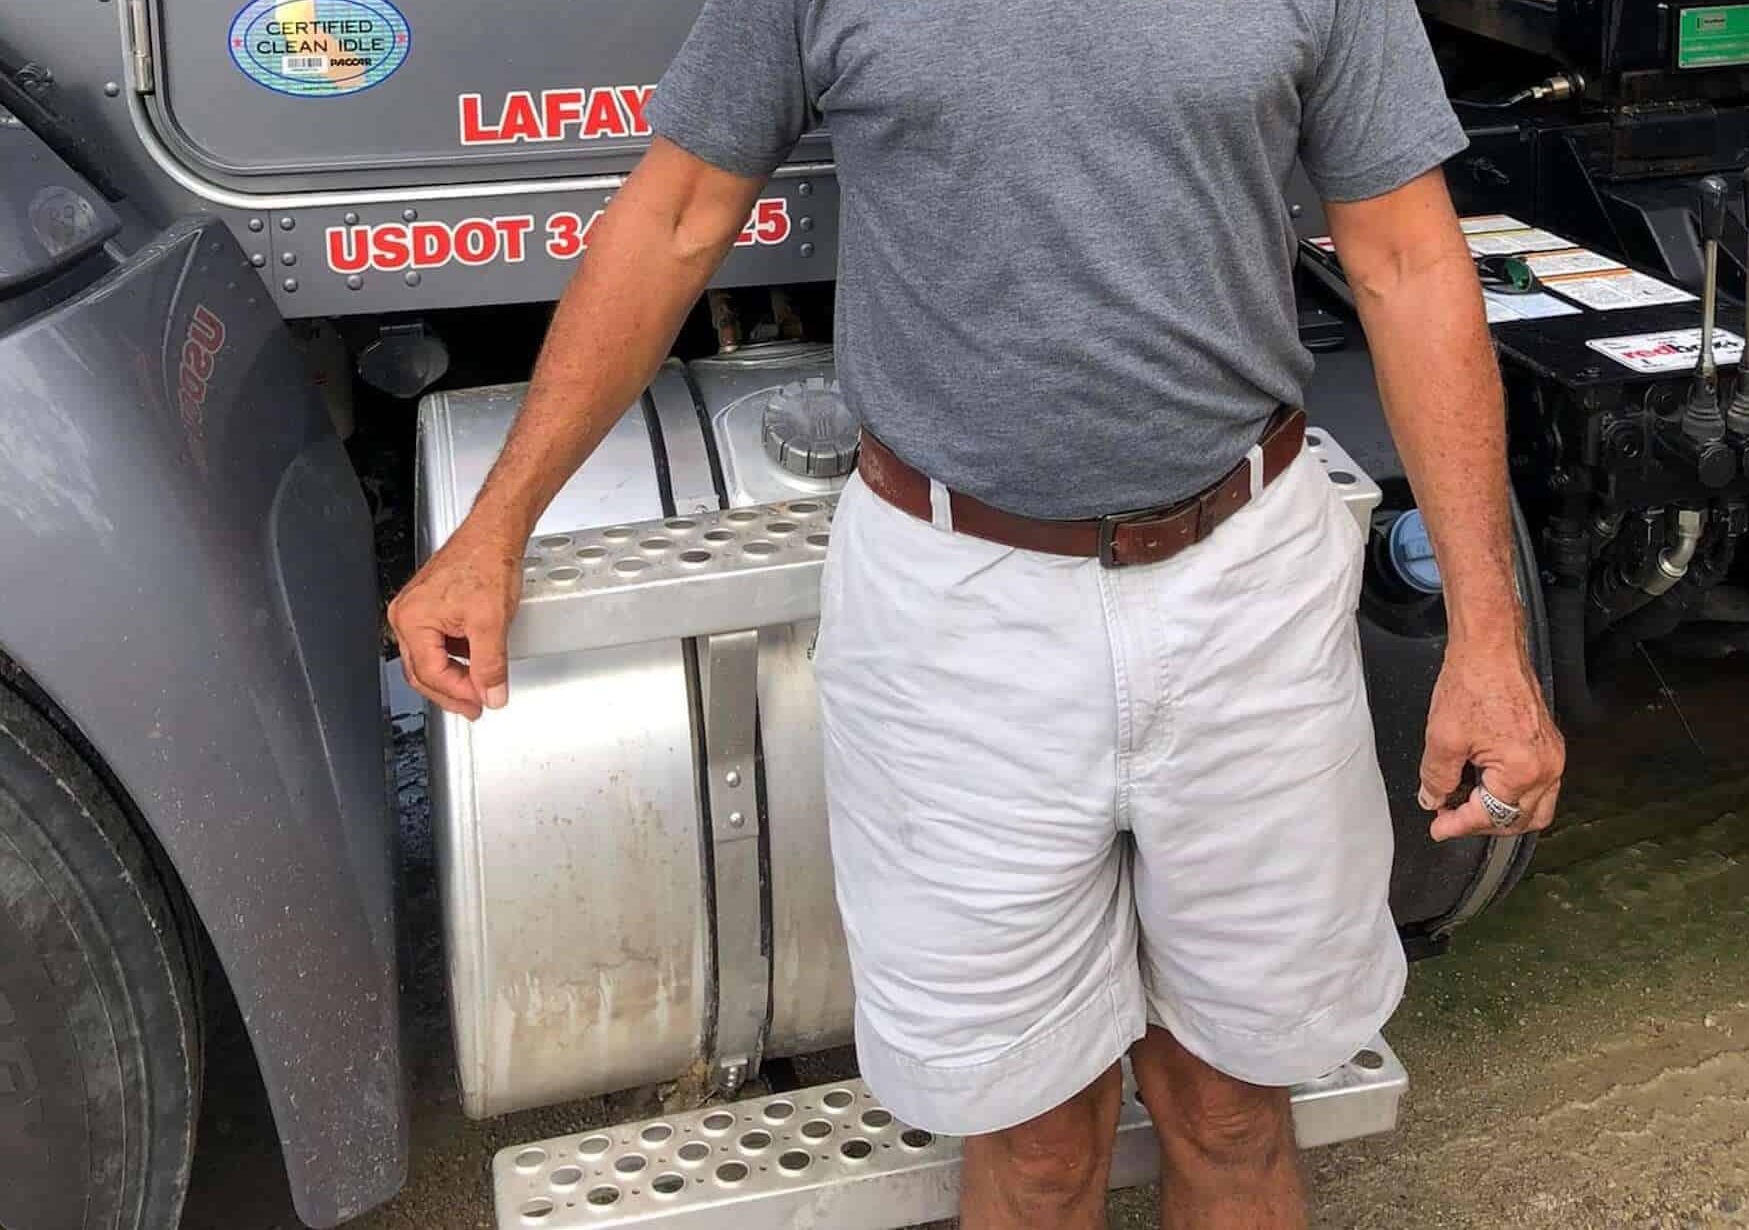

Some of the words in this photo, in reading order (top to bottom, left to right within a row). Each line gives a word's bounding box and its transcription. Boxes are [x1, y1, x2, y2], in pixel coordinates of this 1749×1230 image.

[266, 20, 374, 36] CERTIFIED
[256, 40, 328, 54] CLEAN
[338, 38, 385, 53] IDLE
[330, 57, 372, 67] PACCAR
[326, 216, 534, 273] USDOT
